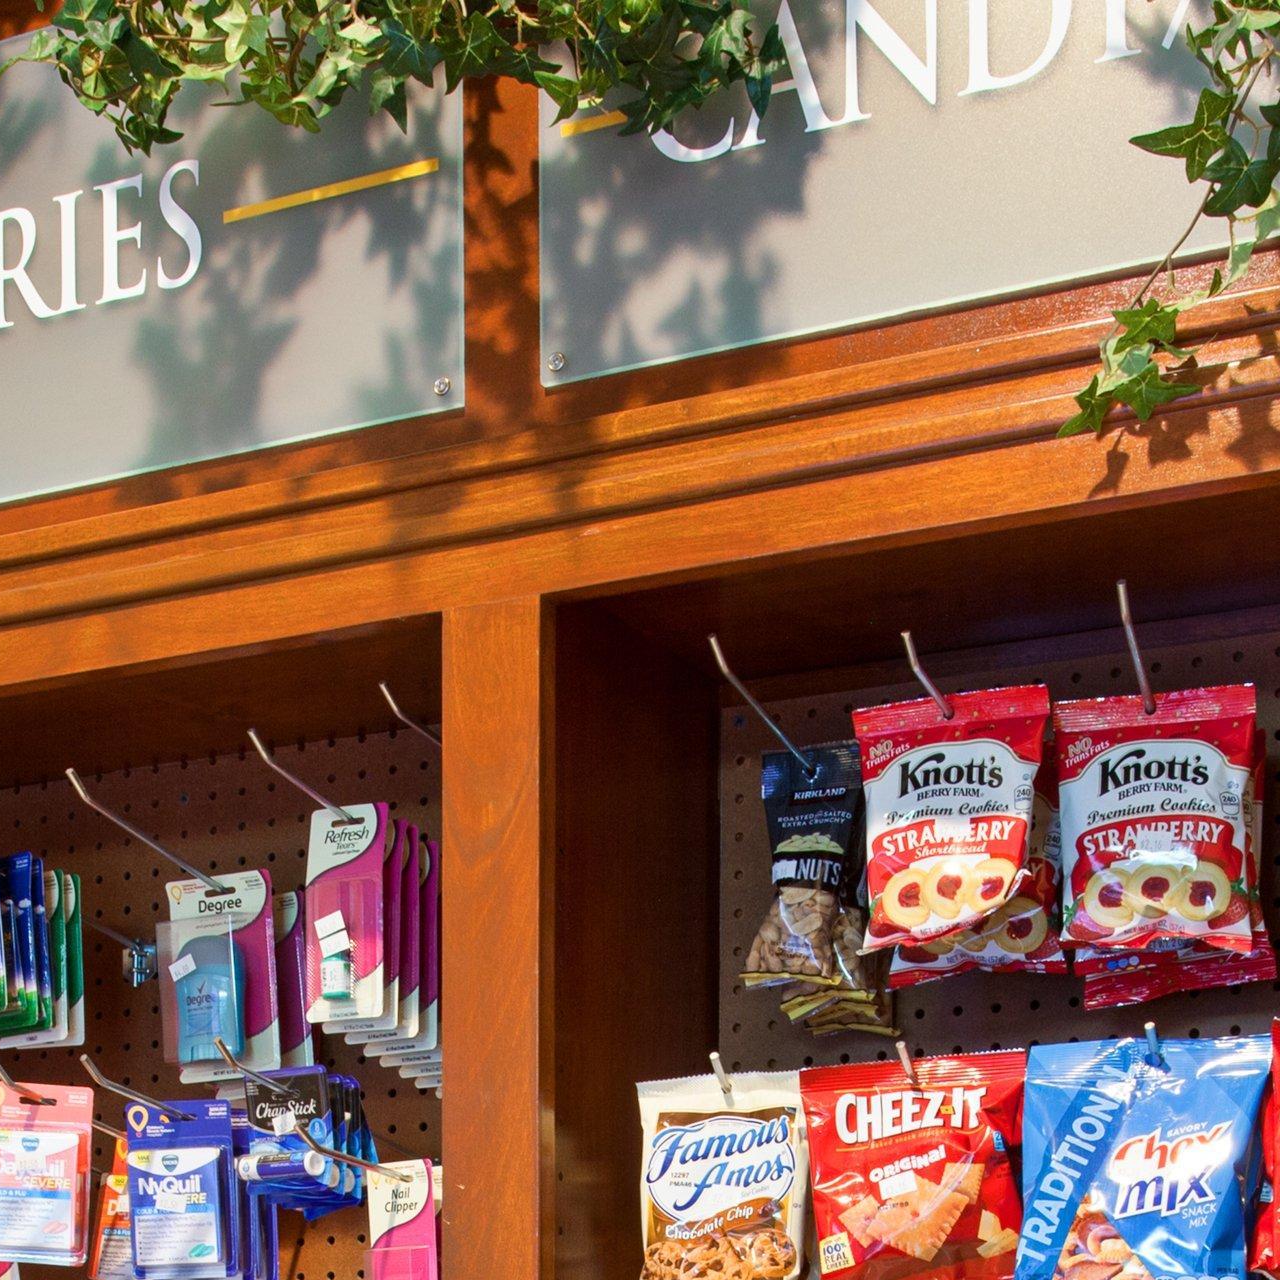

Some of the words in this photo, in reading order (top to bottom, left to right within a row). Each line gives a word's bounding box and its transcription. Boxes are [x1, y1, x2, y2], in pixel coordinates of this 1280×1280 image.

[647, 0, 1142, 162] AND
[898, 753, 1003, 798] Knott's
[1099, 749, 1209, 796] Knott's
[794, 787, 846, 800] KIRKLAND
[916, 787, 952, 801] BERRY
[953, 787, 980, 797] FARM
[1118, 783, 1153, 800] BERRY
[1154, 783, 1183, 795] FARM
[959, 801, 1009, 815] Cookies
[1087, 803, 1155, 826] Premium
[1160, 797, 1216, 814] Cookies
[778, 813, 813, 823] ROASTED
[782, 820, 807, 828] EXTRA
[809, 816, 846, 826] CRUNCHY
[324, 826, 370, 844] Refresh
[198, 897, 242, 914] Degree
[255, 1099, 317, 1120] ChapStick
[835, 1085, 987, 1144] CHEEZ-IT
[646, 1115, 791, 1183] Famous
[22, 1176, 70, 1189] SEVERE
[138, 1173, 201, 1204] NyQuil
[673, 1150, 795, 1211] Amos
[391, 1188, 411, 1199] Nail
[384, 1200, 418, 1213] Clipper
[1182, 1203, 1216, 1219] SNACK
[665, 1217, 724, 1243] Chocolate
[726, 1205, 754, 1223] Chip
[1189, 1217, 1207, 1229] MIX
[824, 1251, 848, 1263] REAL
